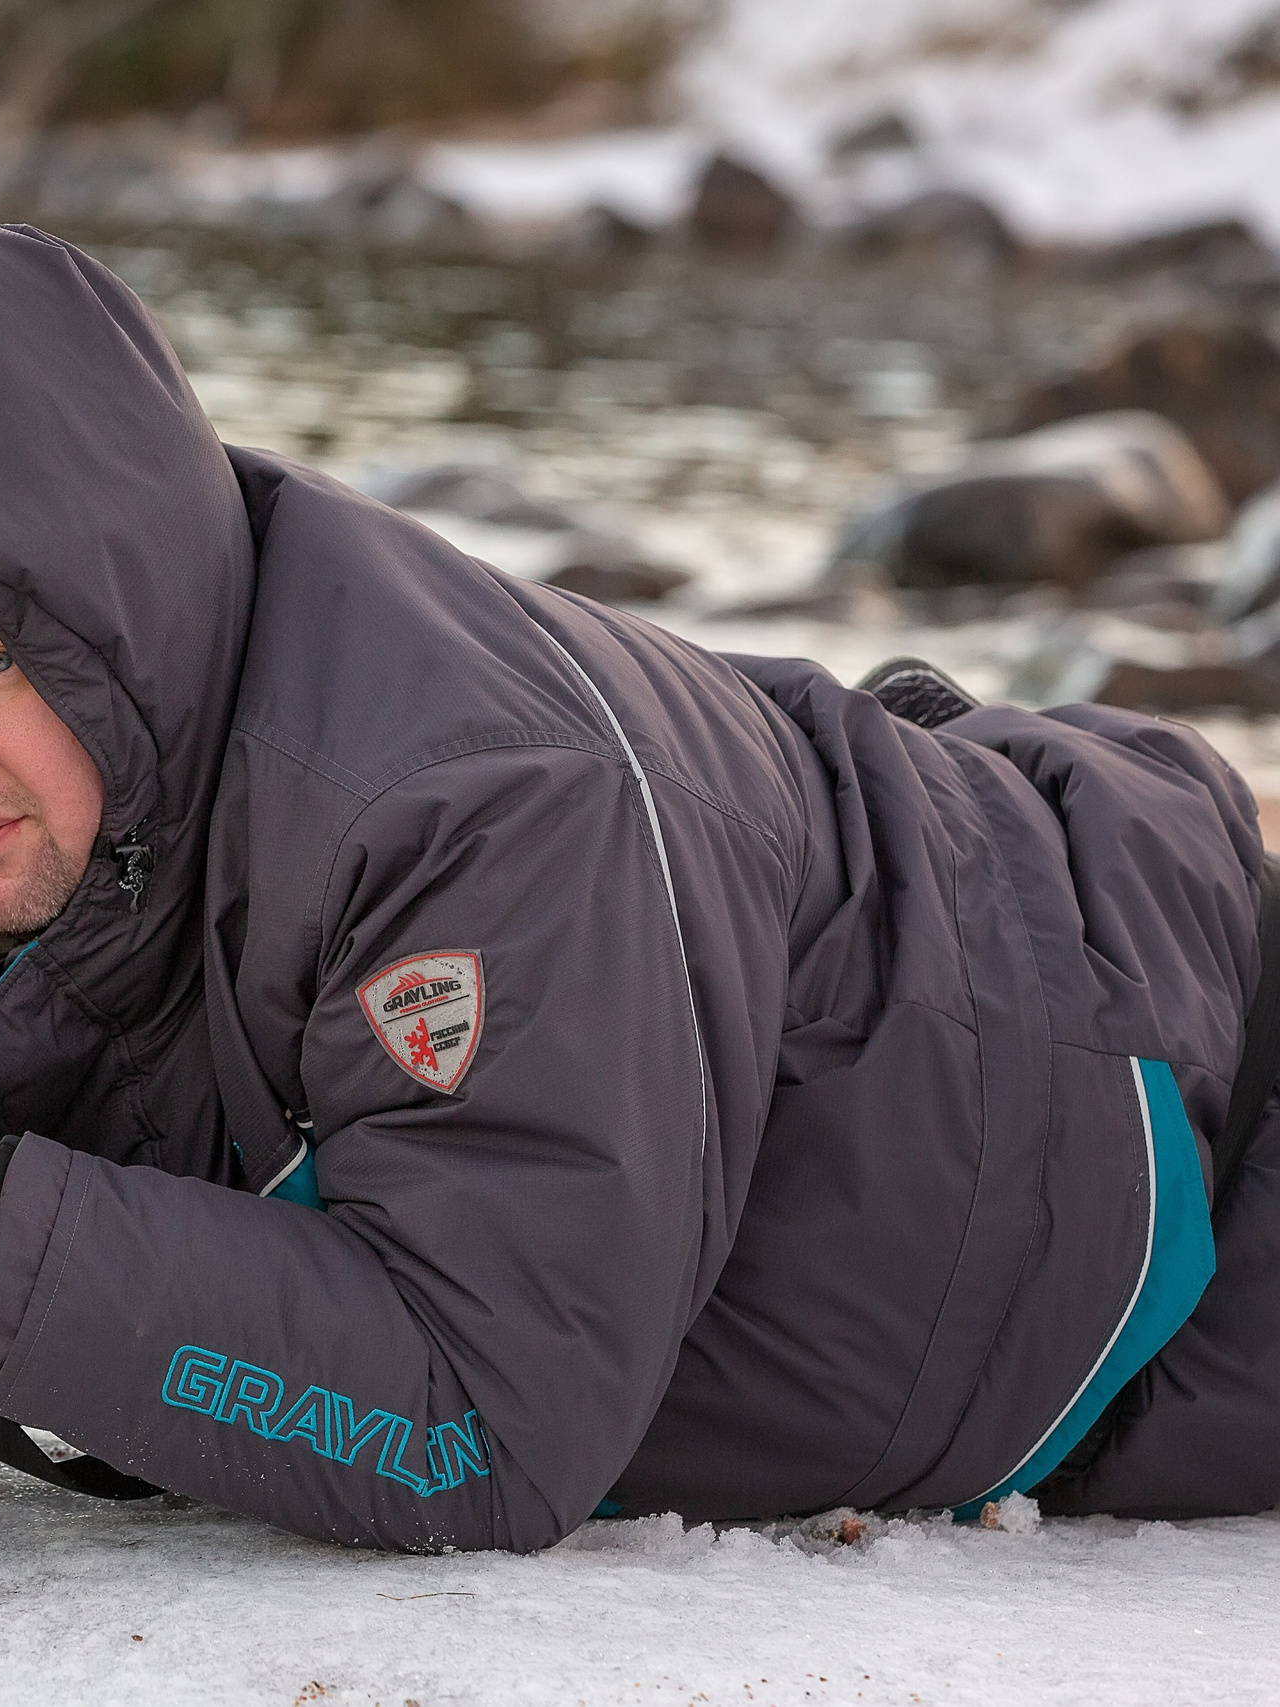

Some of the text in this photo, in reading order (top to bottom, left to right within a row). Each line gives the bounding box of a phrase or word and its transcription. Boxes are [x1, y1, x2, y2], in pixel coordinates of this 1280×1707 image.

[383, 980, 461, 1012] GRAYLING
[429, 1019, 470, 1041] РУССКИЙ
[433, 1036, 461, 1053] СЕВЕР
